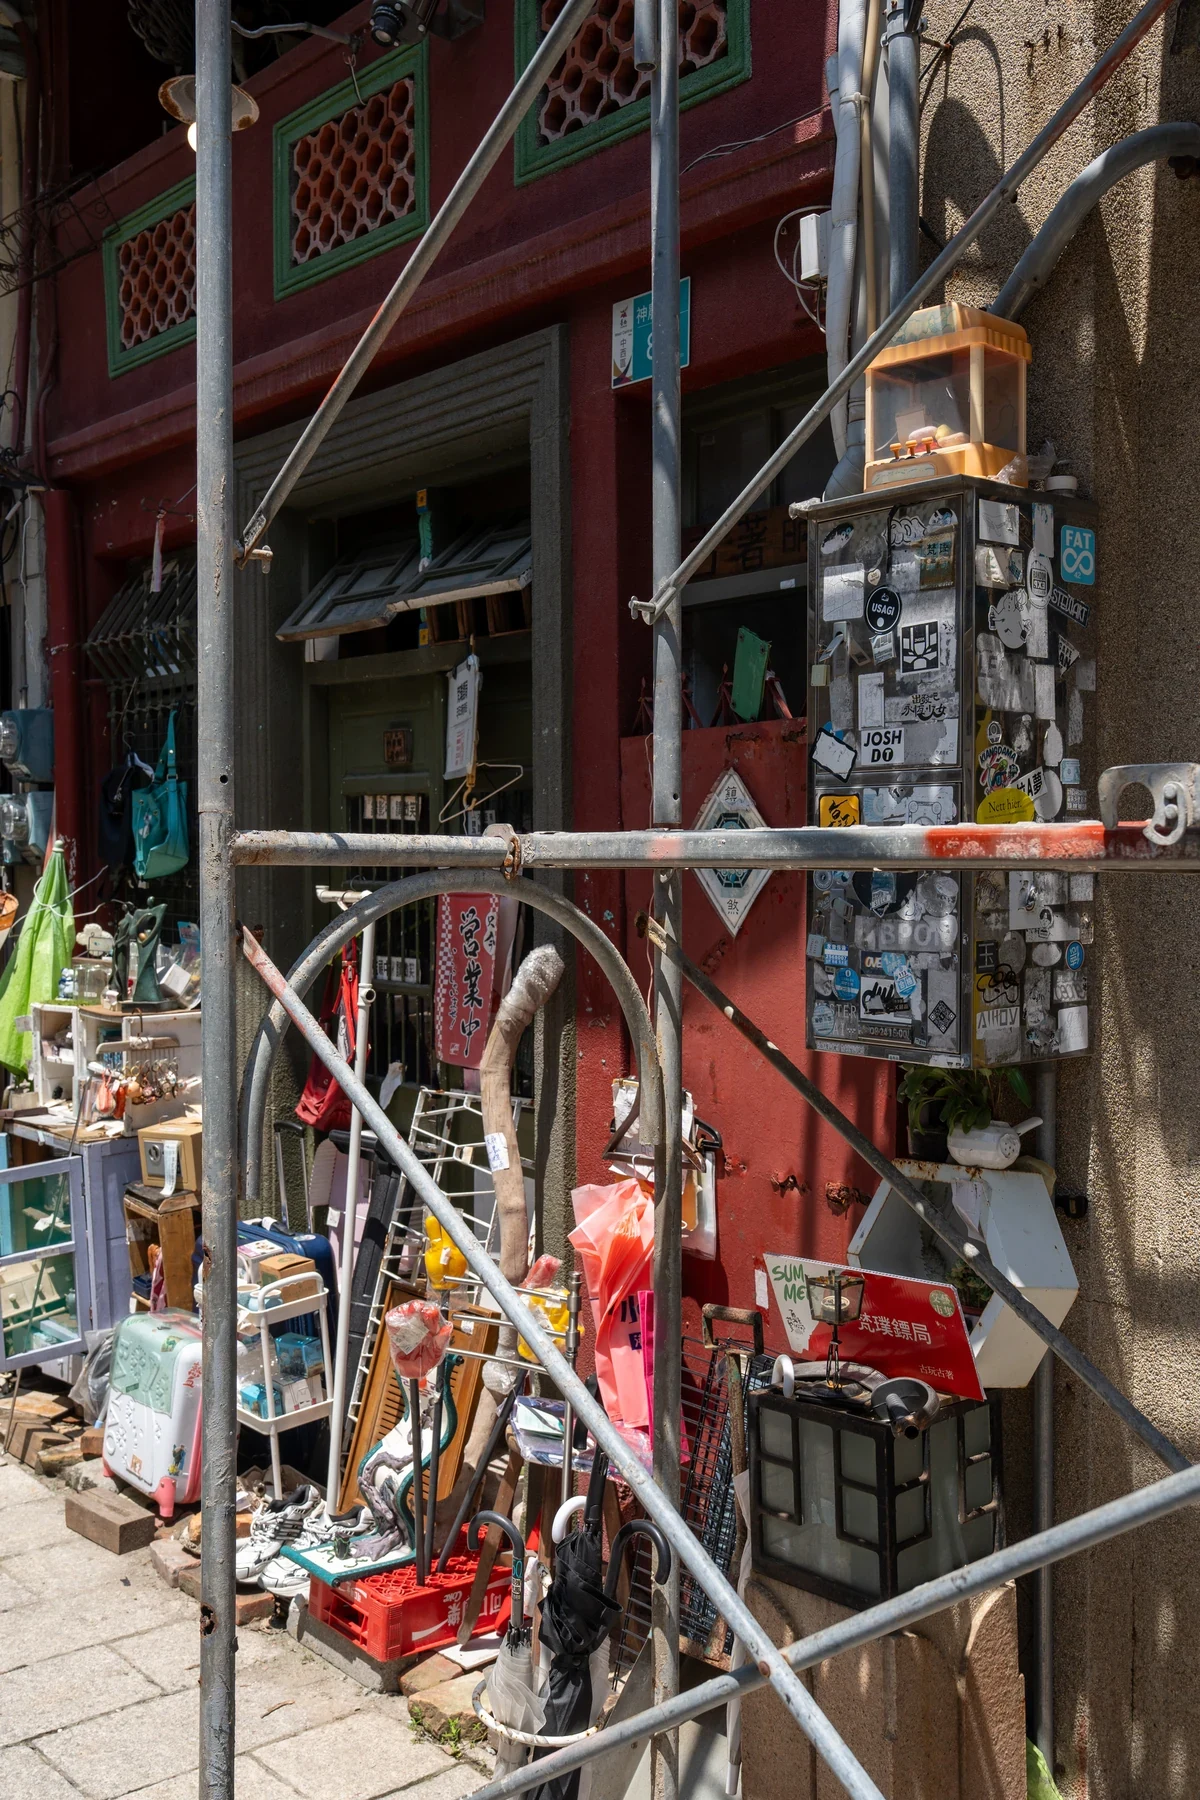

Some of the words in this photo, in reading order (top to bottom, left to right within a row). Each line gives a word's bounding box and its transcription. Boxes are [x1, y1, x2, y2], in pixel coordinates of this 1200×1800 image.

[1065, 529, 1092, 550] FAT
[871, 602, 896, 616] USAGI
[863, 729, 903, 747] JOSH
[988, 801, 1005, 813] Nett
[1006, 798, 1022, 811] hier.
[459, 906, 484, 1059] 営業中
[771, 1263, 805, 1283] SUM
[858, 1312, 933, 1346] 梵璞鏢局
[919, 1363, 955, 1381] 古玩古著
[447, 1592, 502, 1627] 可口樂
